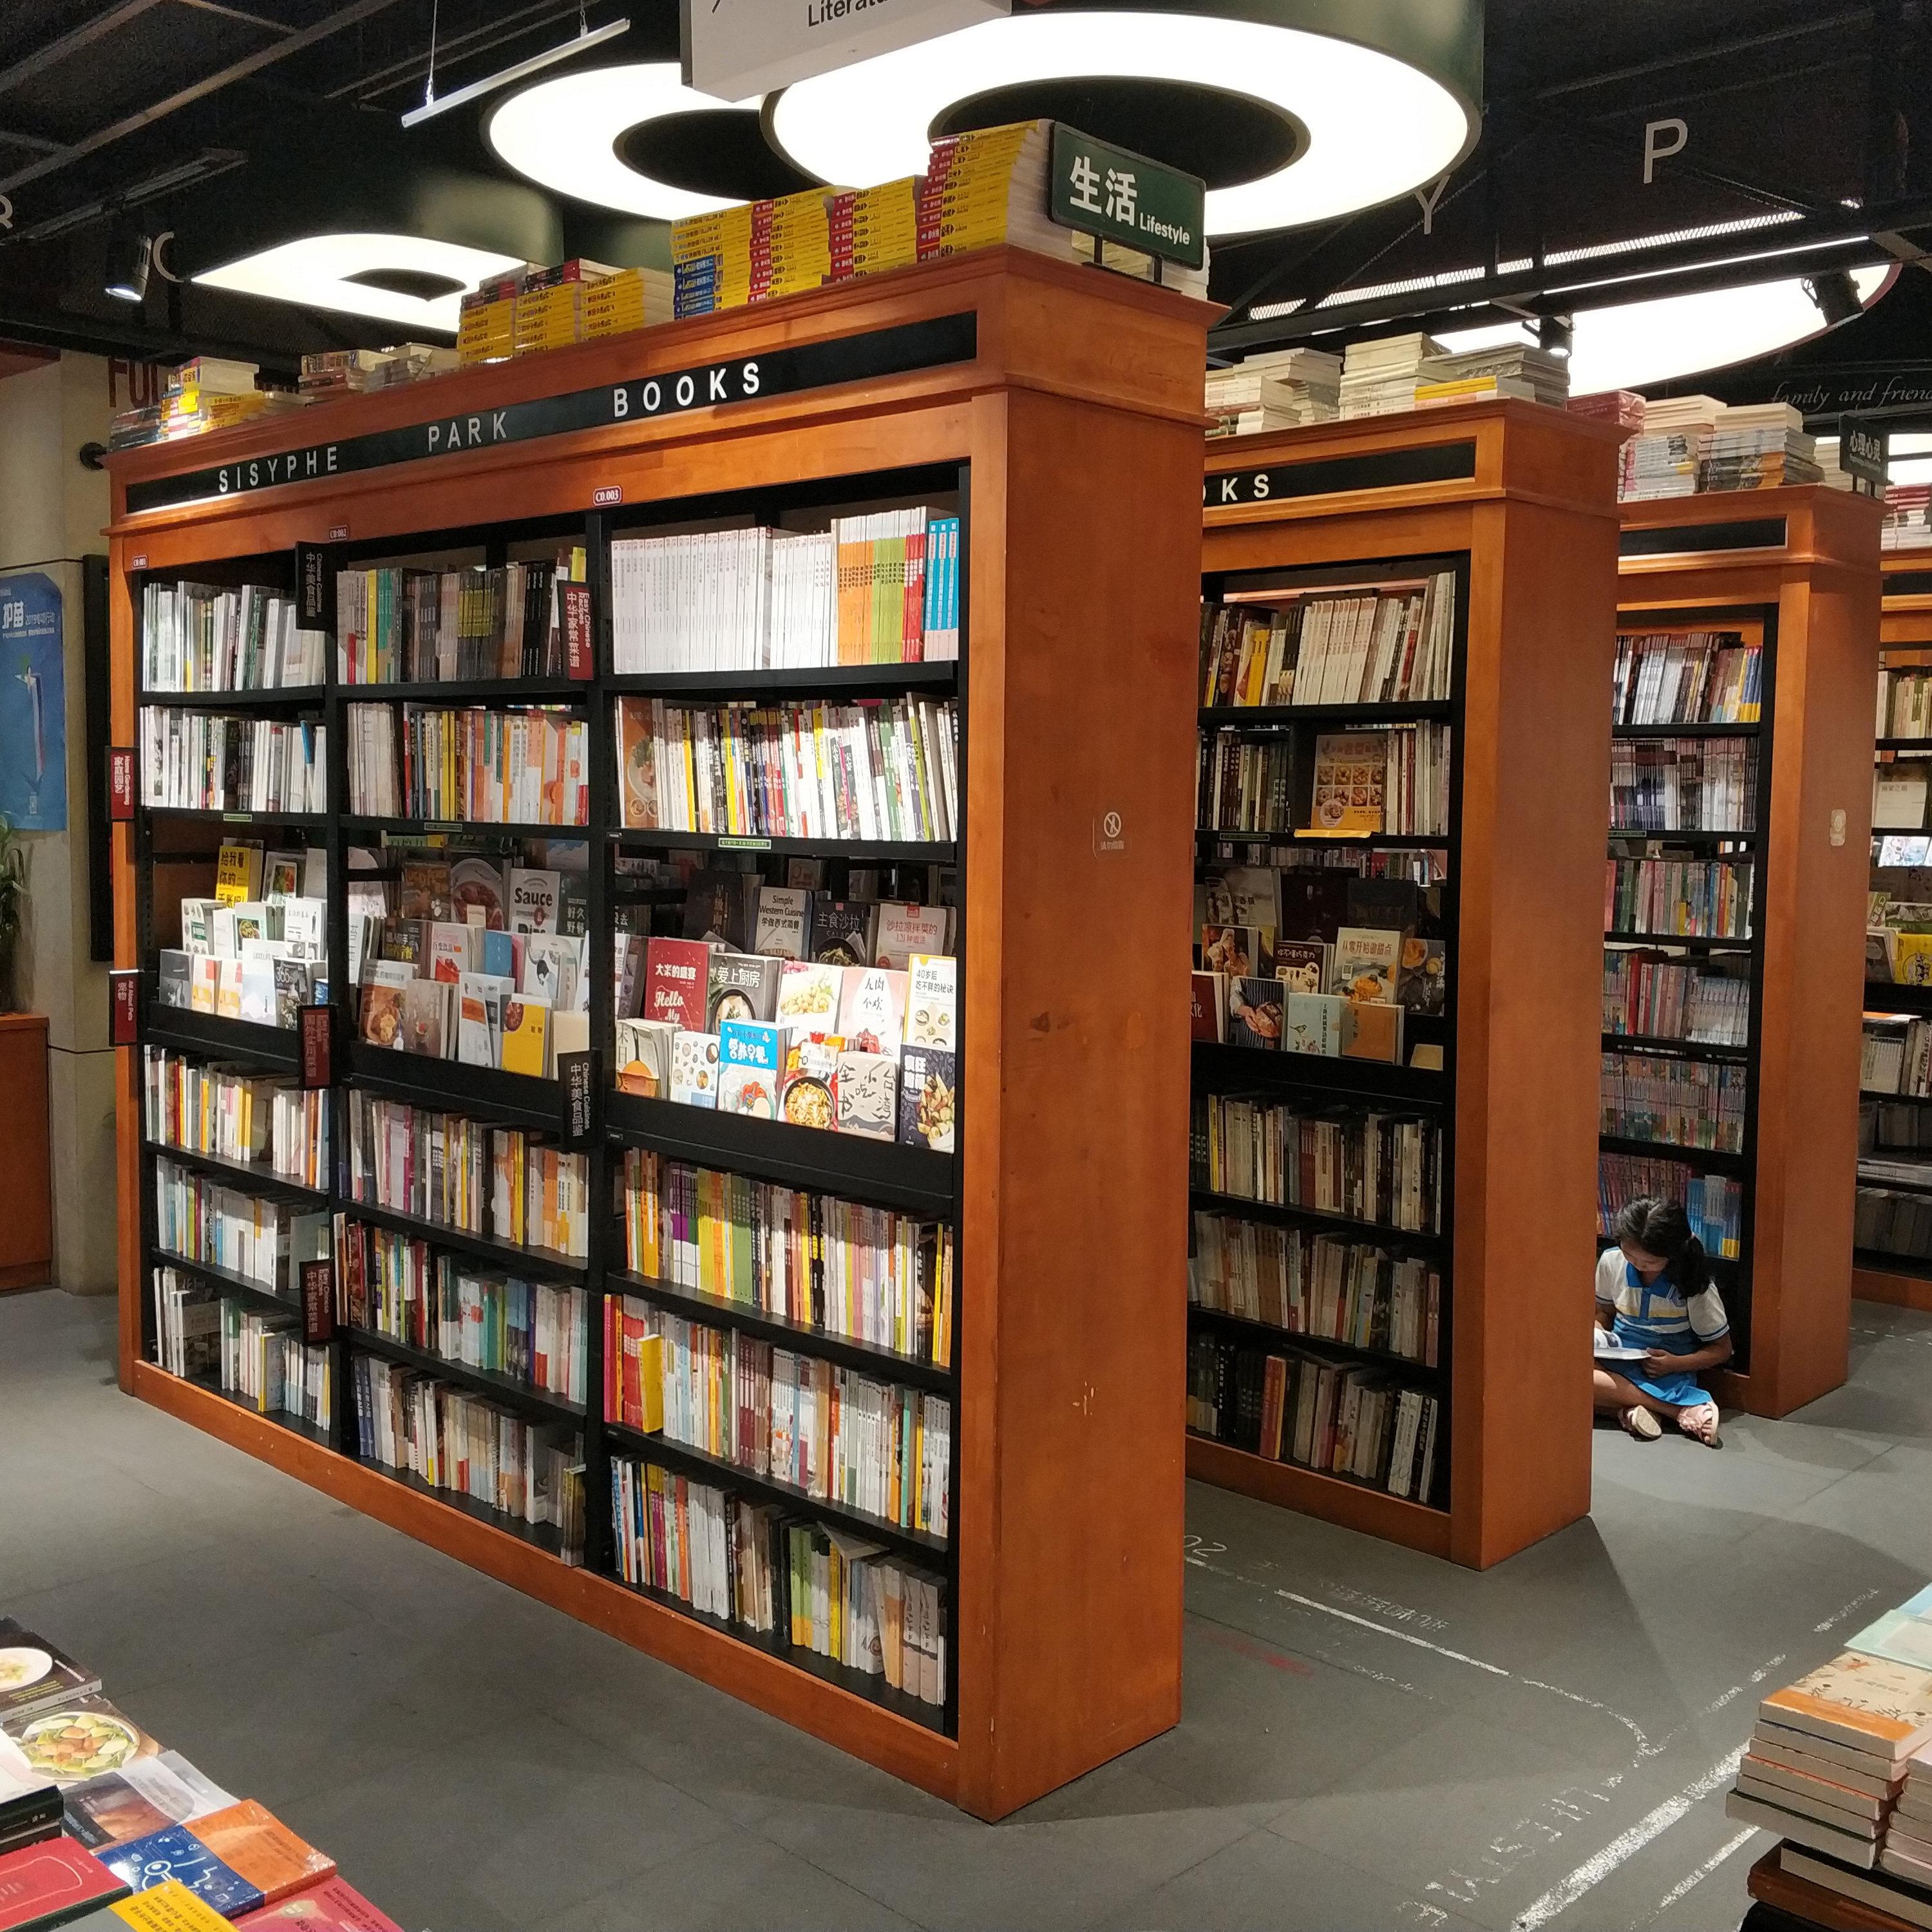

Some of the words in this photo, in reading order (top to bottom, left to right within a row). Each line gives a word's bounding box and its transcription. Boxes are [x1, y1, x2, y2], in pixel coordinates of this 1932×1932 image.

[808, 0, 889, 27] Litera
[1644, 118, 1688, 184] P
[1070, 156, 1137, 225] 生活
[1139, 212, 1191, 245] Lifestyle
[1772, 381, 1830, 413] family
[1839, 382, 1877, 401] and
[219, 447, 337, 493] SISYPHE
[428, 412, 507, 451] PARK
[613, 362, 760, 417] BOOKS
[1202, 474, 1269, 502] KS
[514, 887, 553, 907] Sauce
[772, 895, 794, 905] Simple
[759, 907, 784, 915] Western
[817, 911, 860, 931] 主食沙拉
[275, 967, 290, 983] 365
[655, 963, 696, 981] 大米的盛宴
[717, 967, 761, 988] 爱上厨房
[916, 969, 938, 981] 40岁后
[654, 989, 684, 1008] Hello
[665, 1009, 680, 1023] My
[871, 1068, 896, 1119] 台湾
